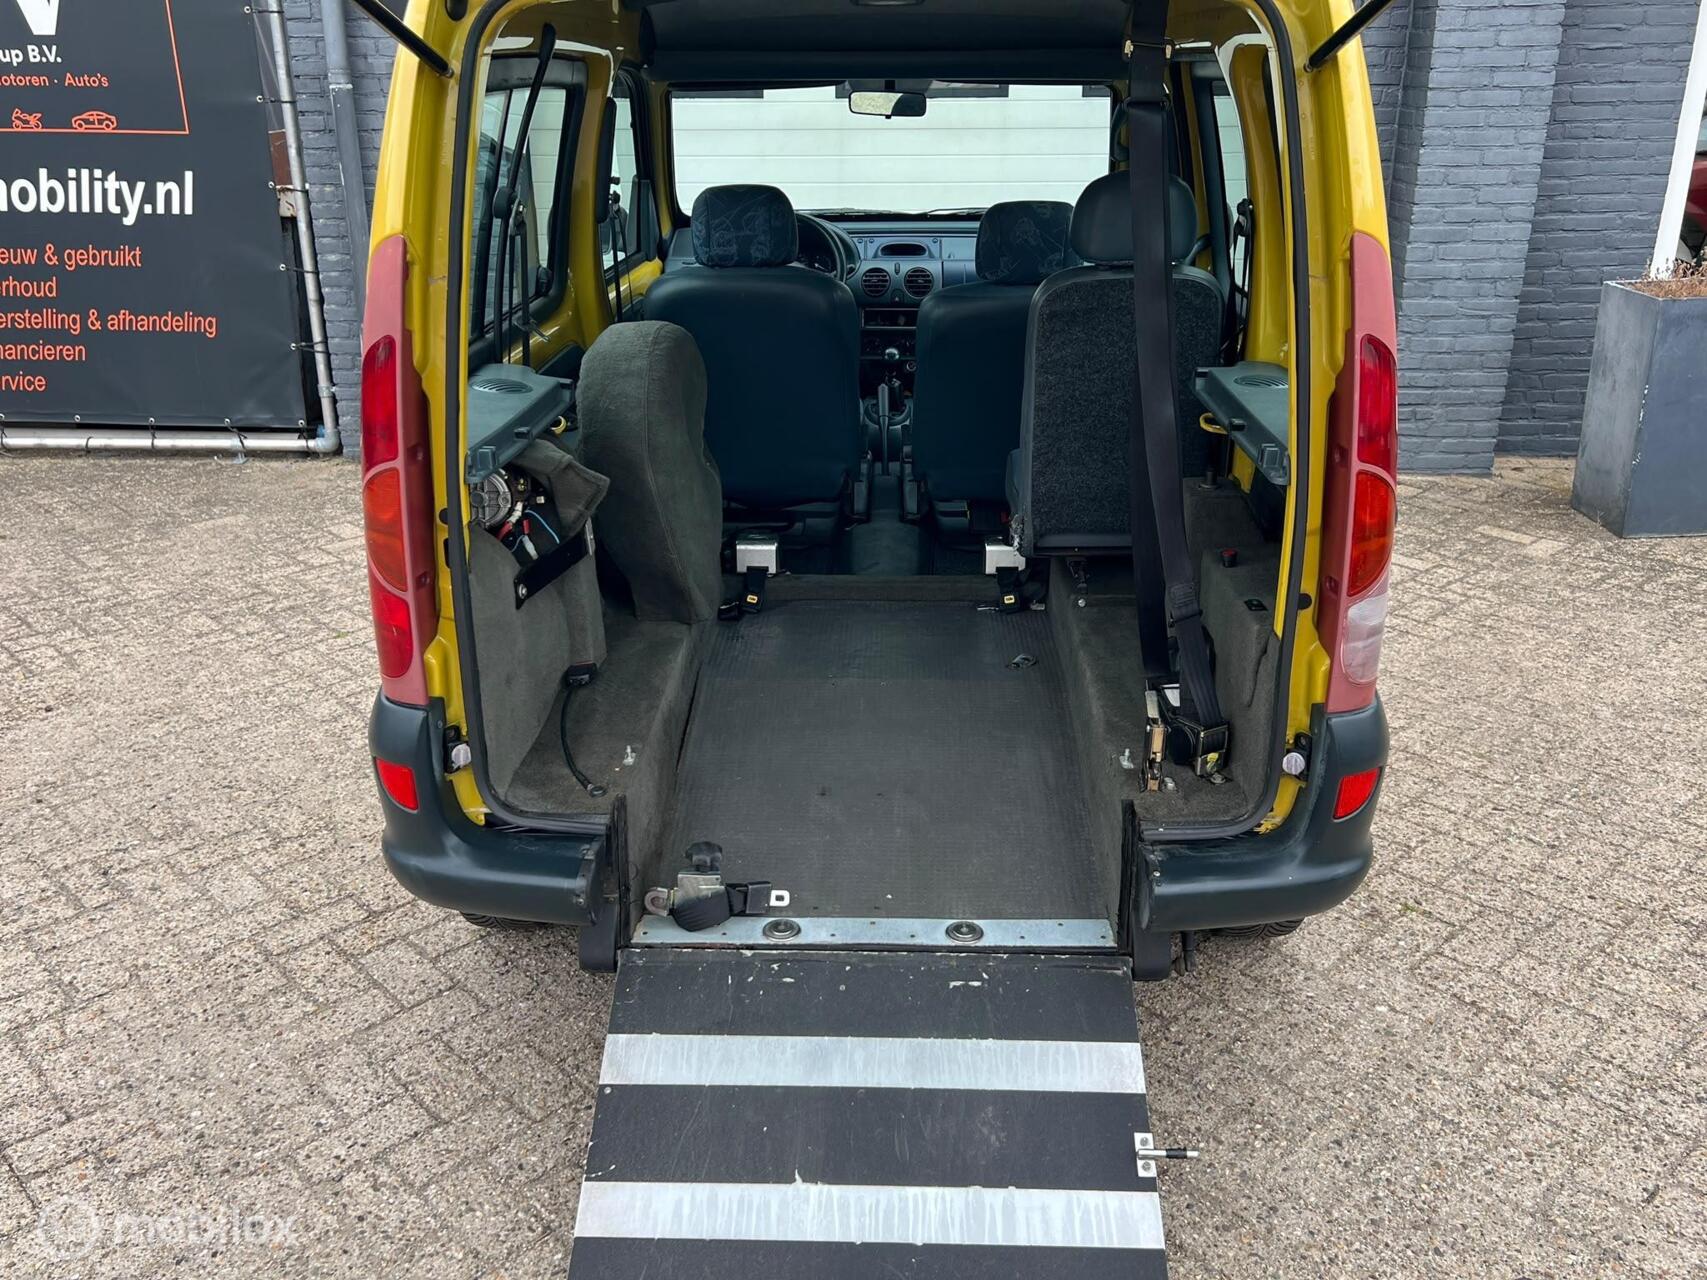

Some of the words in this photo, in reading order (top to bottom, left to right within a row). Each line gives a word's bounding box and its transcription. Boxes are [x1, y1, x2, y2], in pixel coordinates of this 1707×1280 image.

[27, 44, 62, 63] B.V.
[0, 74, 49, 87] otoren
[44, 243, 59, 265] &
[64, 244, 142, 271] gebruikt
[0, 275, 57, 297] rhoud
[87, 308, 102, 331] &
[107, 309, 217, 338] afhandeling
